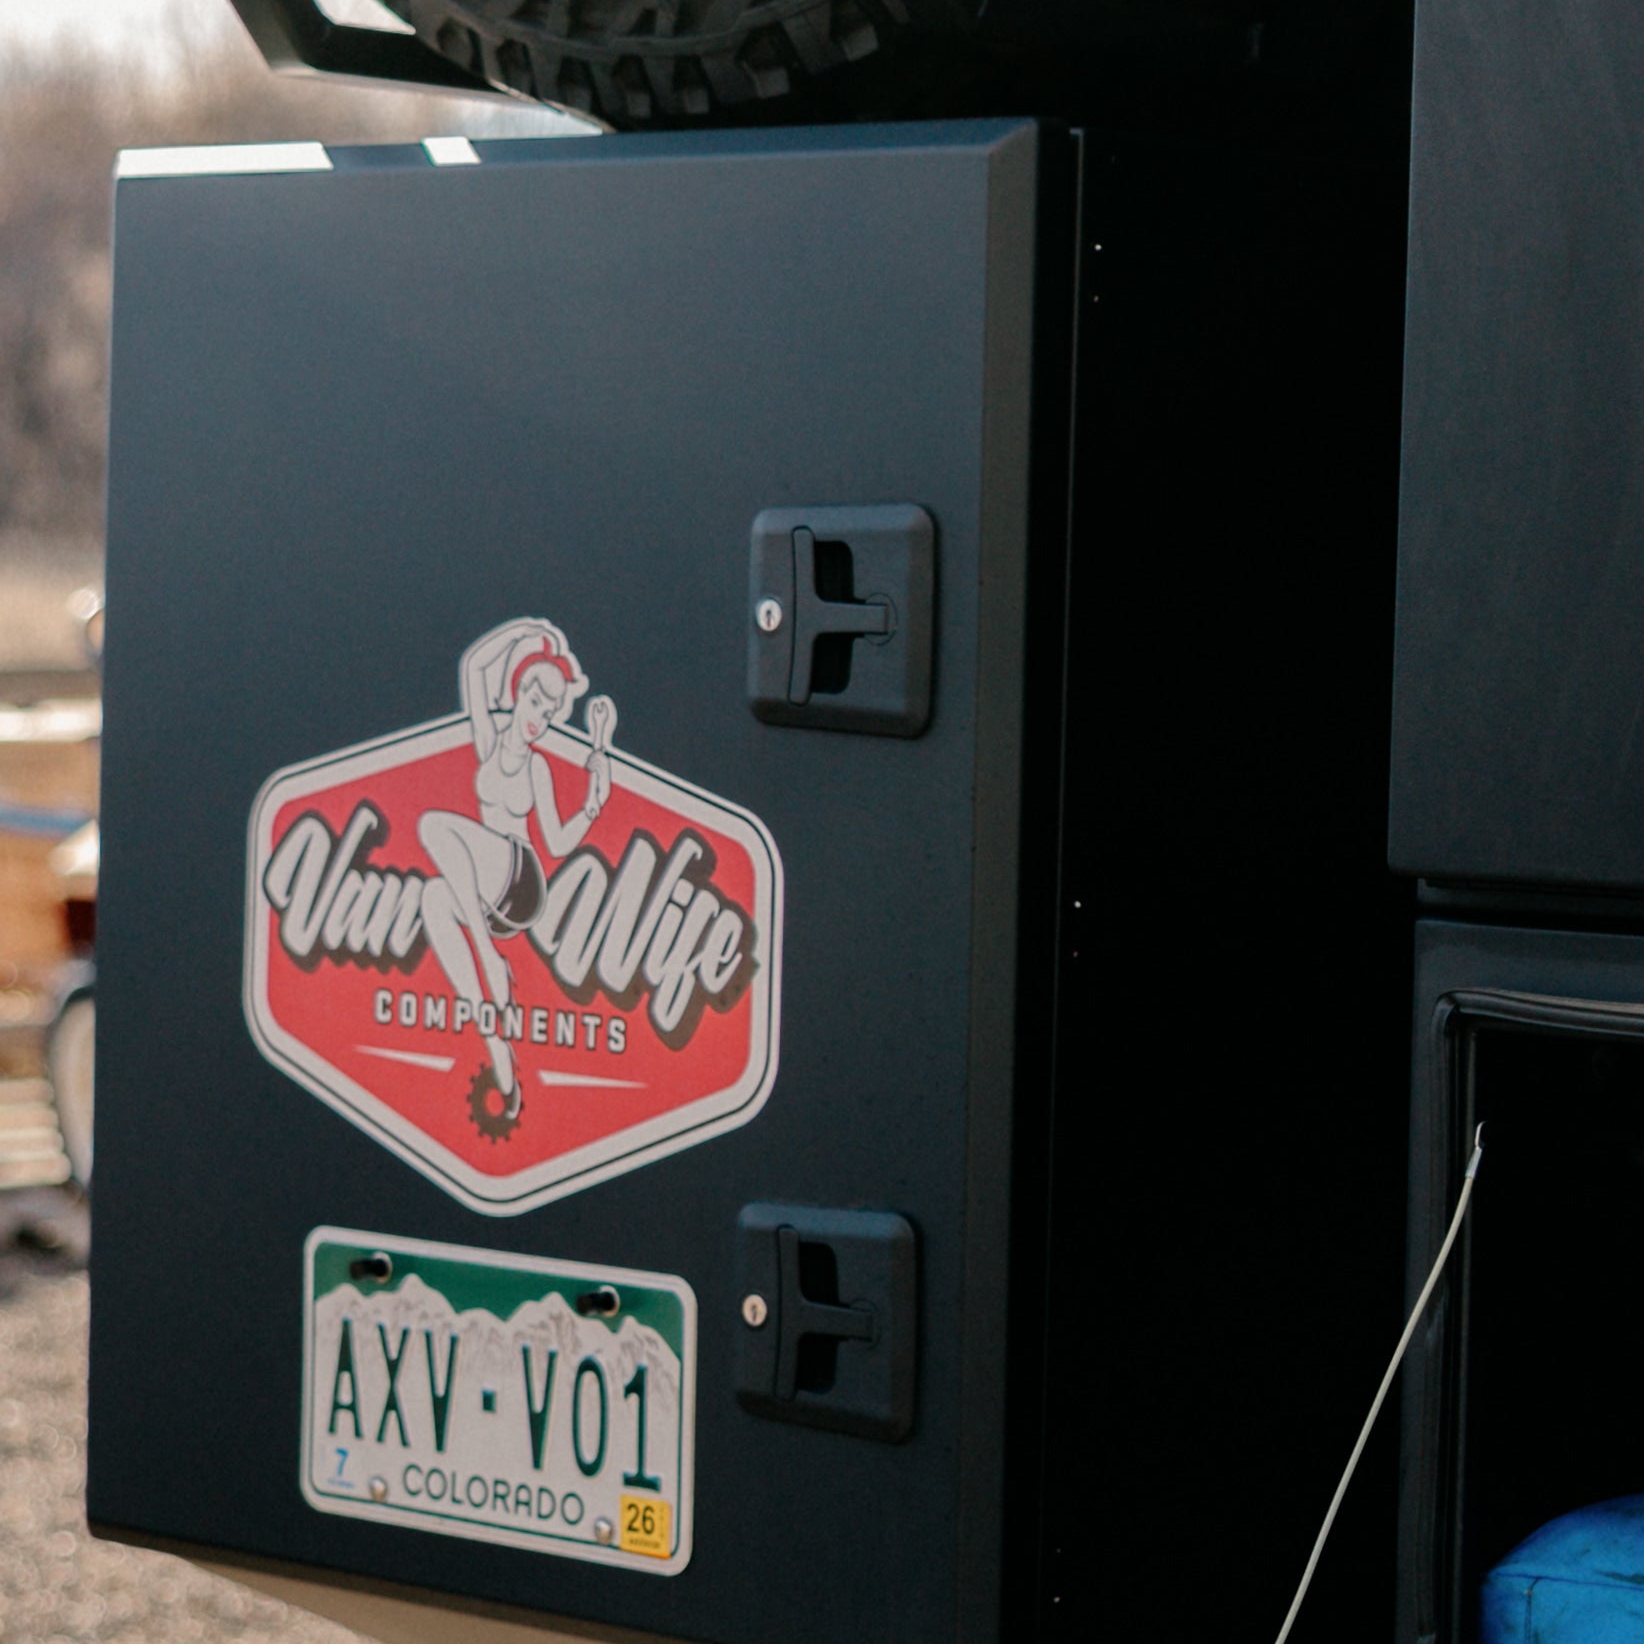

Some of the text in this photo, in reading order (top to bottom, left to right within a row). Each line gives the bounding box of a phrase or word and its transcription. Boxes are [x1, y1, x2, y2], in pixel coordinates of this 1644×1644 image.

[263, 799, 747, 1038] Van Wife
[372, 988, 630, 1055] COMPONENTS
[334, 1447, 350, 1477] 7
[402, 1463, 586, 1526] COLORADO
[626, 1502, 656, 1536] 26
